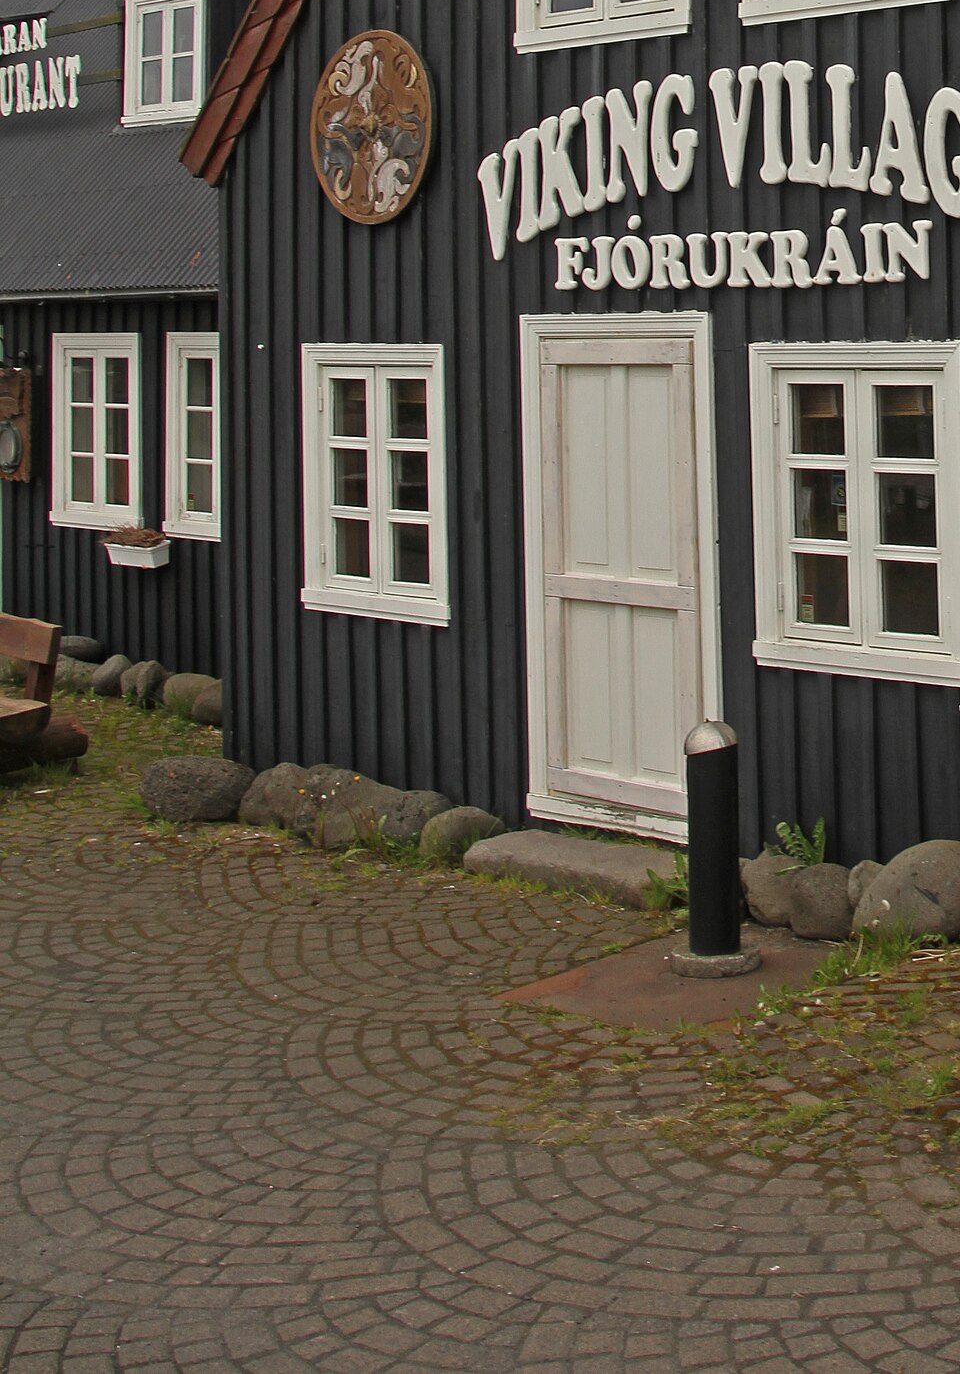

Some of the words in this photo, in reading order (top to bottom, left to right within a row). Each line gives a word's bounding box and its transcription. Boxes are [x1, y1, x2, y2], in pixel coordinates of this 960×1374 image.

[0, 18, 47, 55] RAN
[478, 74, 698, 261] VIKING
[555, 208, 932, 290] FJÓRUKRÁIN
